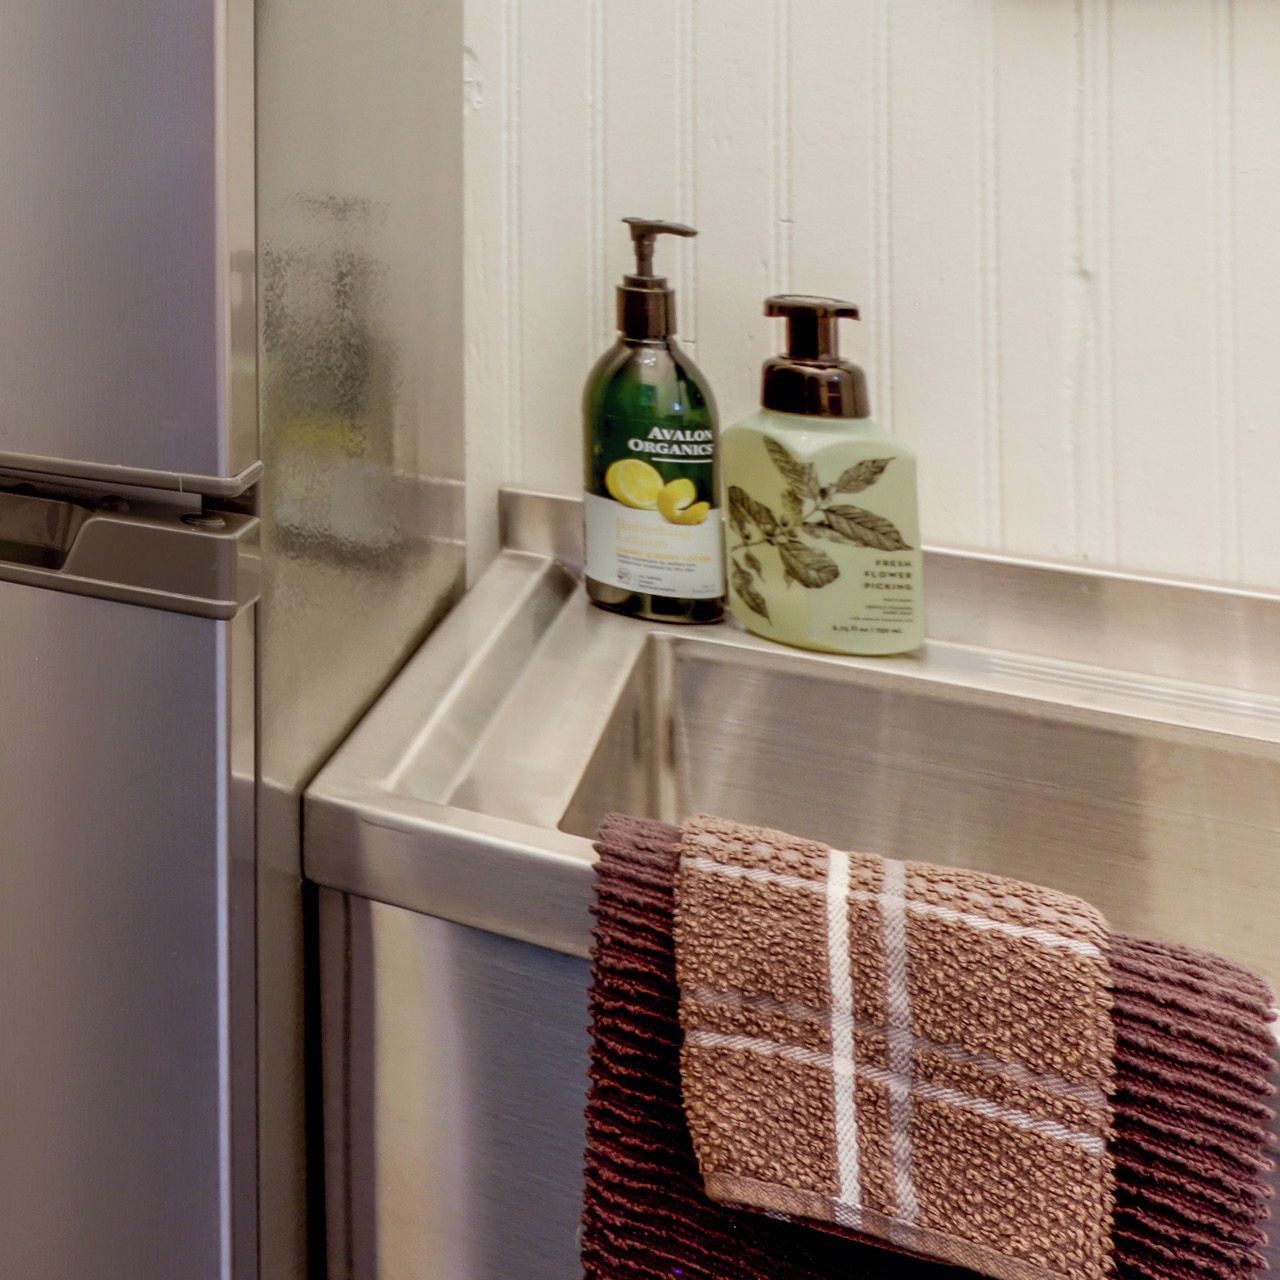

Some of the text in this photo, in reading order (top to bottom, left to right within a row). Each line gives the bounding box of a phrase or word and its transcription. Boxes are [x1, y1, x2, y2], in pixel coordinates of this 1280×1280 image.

[647, 426, 713, 441] AVALON
[627, 438, 714, 456] ORGANICS
[864, 582, 913, 590] PICKING
